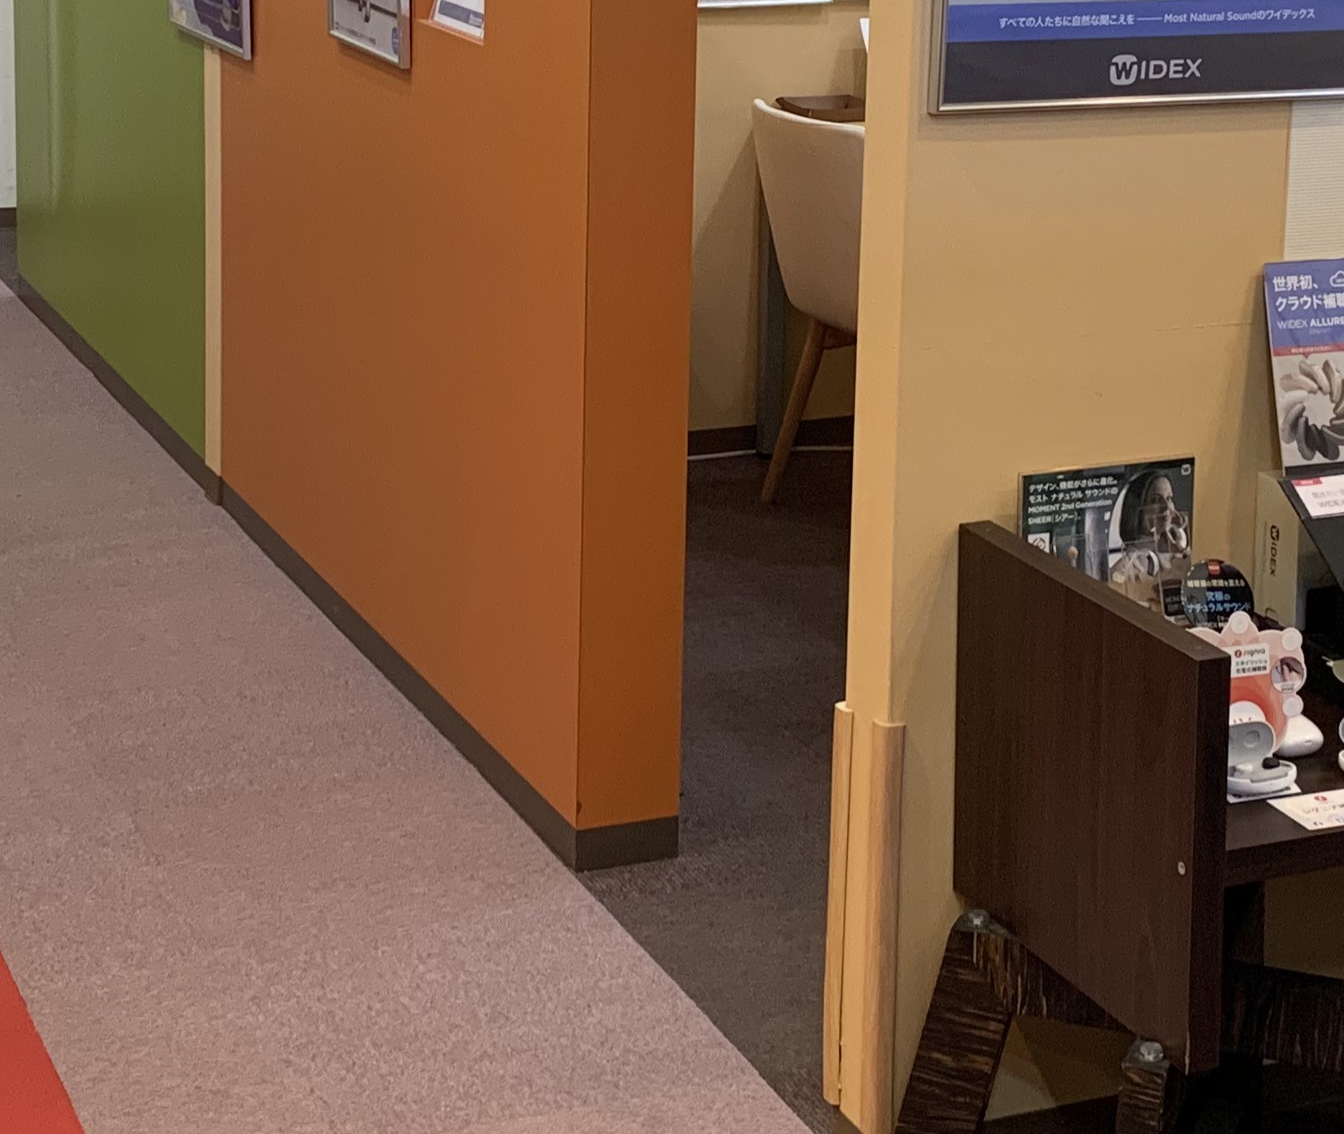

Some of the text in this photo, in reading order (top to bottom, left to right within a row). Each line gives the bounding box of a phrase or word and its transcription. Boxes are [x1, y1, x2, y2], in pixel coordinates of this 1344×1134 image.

[1164, 12, 1188, 24] Most
[1190, 11, 1224, 22] Natural
[1109, 53, 1202, 86] WIDEX
[1273, 275, 1318, 293] 世界初、
[1277, 319, 1308, 330] WIDEX
[1029, 494, 1048, 504] モスト
[1051, 491, 1083, 501] ナチュラル
[1028, 499, 1113, 514] MOMENT 2nd Generation
[1269, 524, 1281, 577] WIDEX
